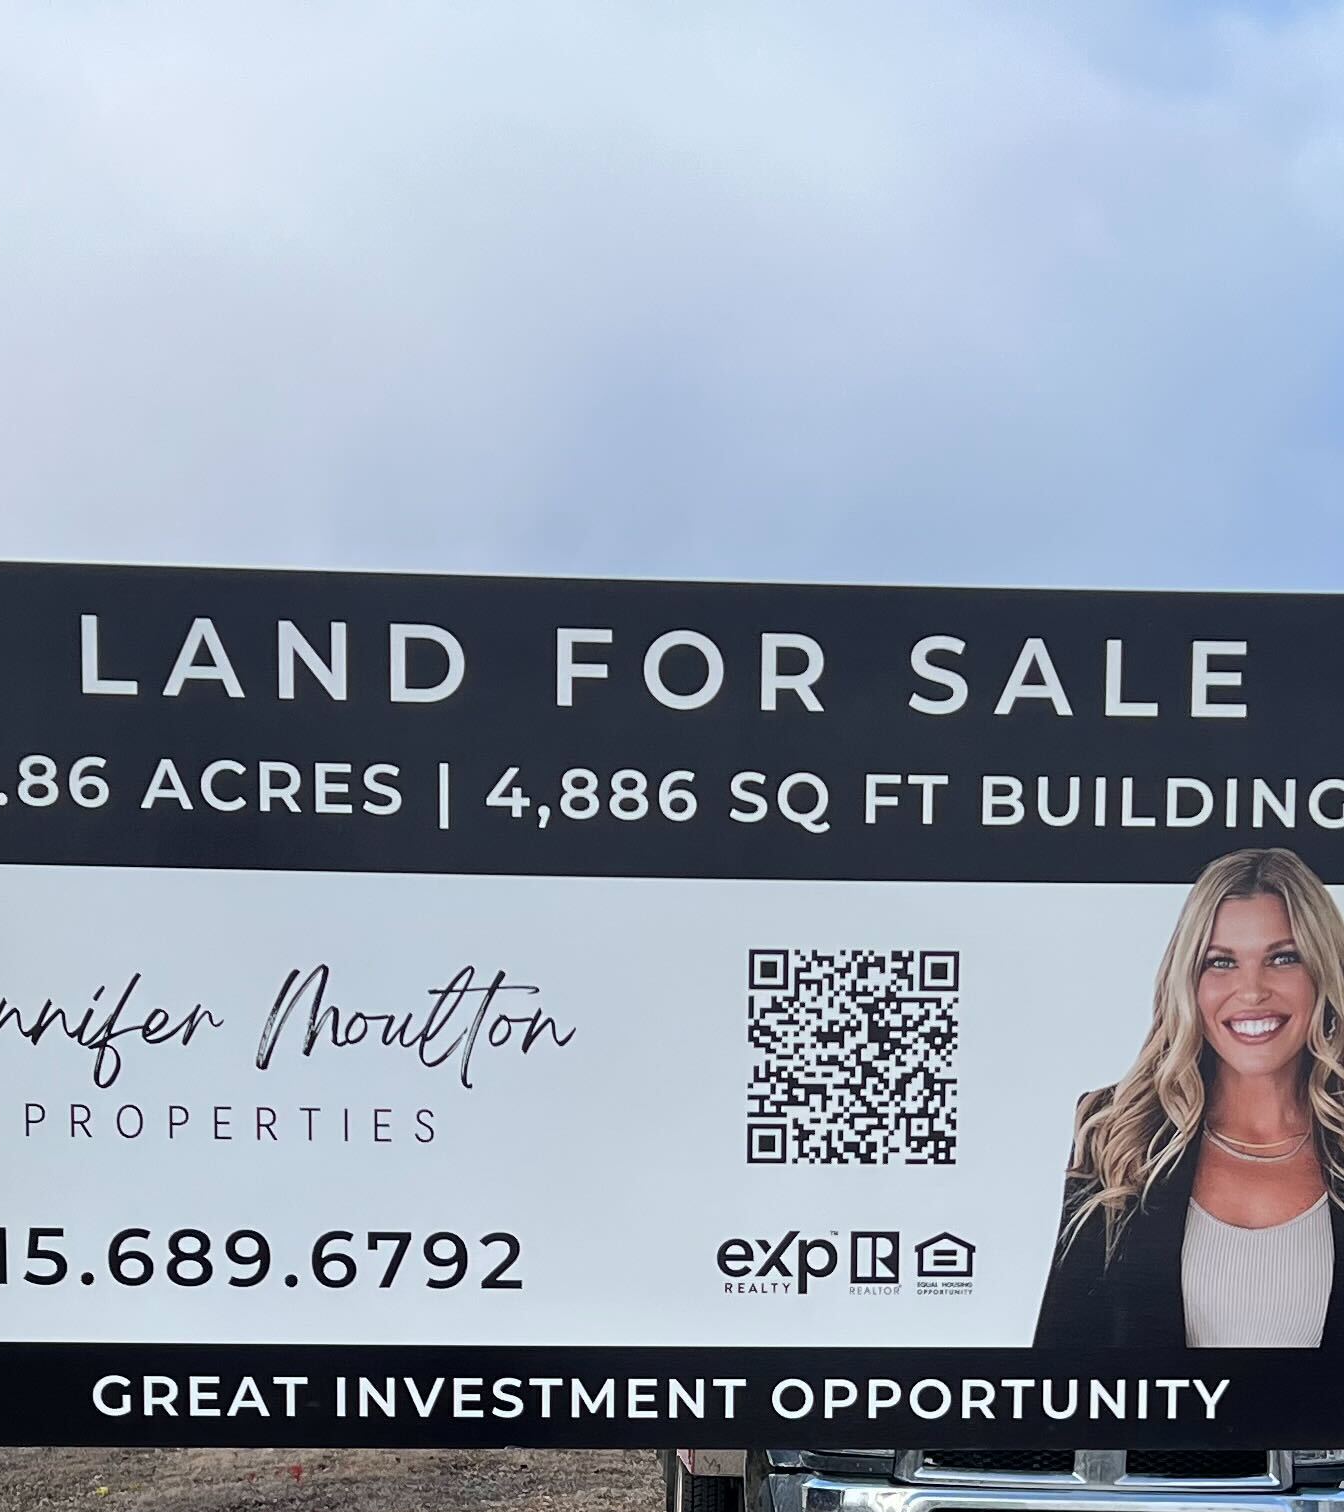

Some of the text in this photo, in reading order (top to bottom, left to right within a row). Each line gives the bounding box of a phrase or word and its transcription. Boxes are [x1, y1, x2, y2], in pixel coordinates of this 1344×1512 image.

[81, 614, 1247, 718] LAND FOR SALE
[140, 758, 402, 816] ACRES
[485, 767, 698, 829] 4,886
[729, 771, 831, 834] SQ
[865, 773, 949, 825] FT
[255, 963, 577, 1090] Moulton
[25, 1103, 435, 1143] PROPERTIES
[724, 1282, 791, 1294] REALTY
[92, 1374, 1230, 1420] GREAT INVESTMENT OPPORTUNITY
